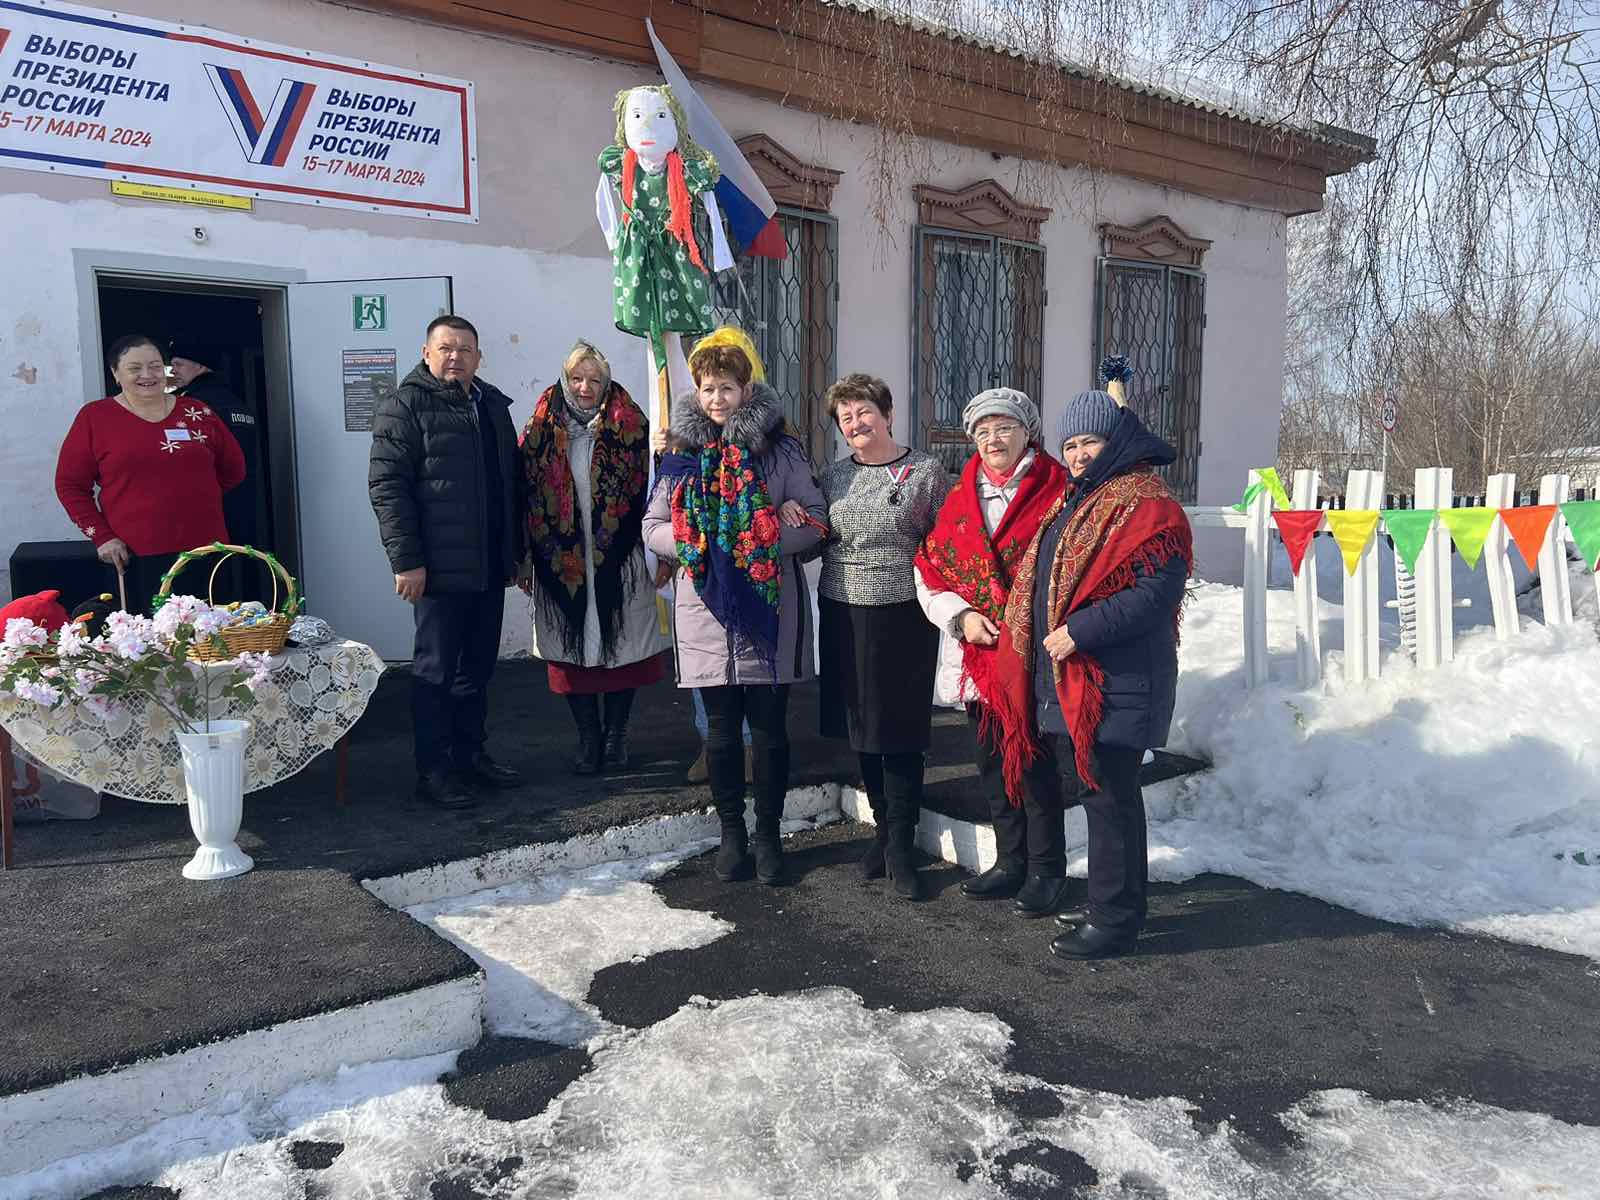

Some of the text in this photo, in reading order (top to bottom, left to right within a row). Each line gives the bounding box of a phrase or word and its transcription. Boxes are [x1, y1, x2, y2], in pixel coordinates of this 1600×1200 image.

[24, 34, 138, 70] ВЫБОРЫ
[12, 59, 170, 102] ПРЕЗИДЕНТА
[1, 85, 106, 117] РОССИИ
[326, 88, 416, 117] ВЫБОРЫ
[0, 111, 152, 148] 5–17 МАРТА 2024
[317, 111, 441, 146] ПРЕЗИДЕНТА
[309, 134, 391, 161] РОССИИ
[302, 155, 425, 186] 15–17 МАРТА 2024
[1384, 408, 1394, 421] 20
